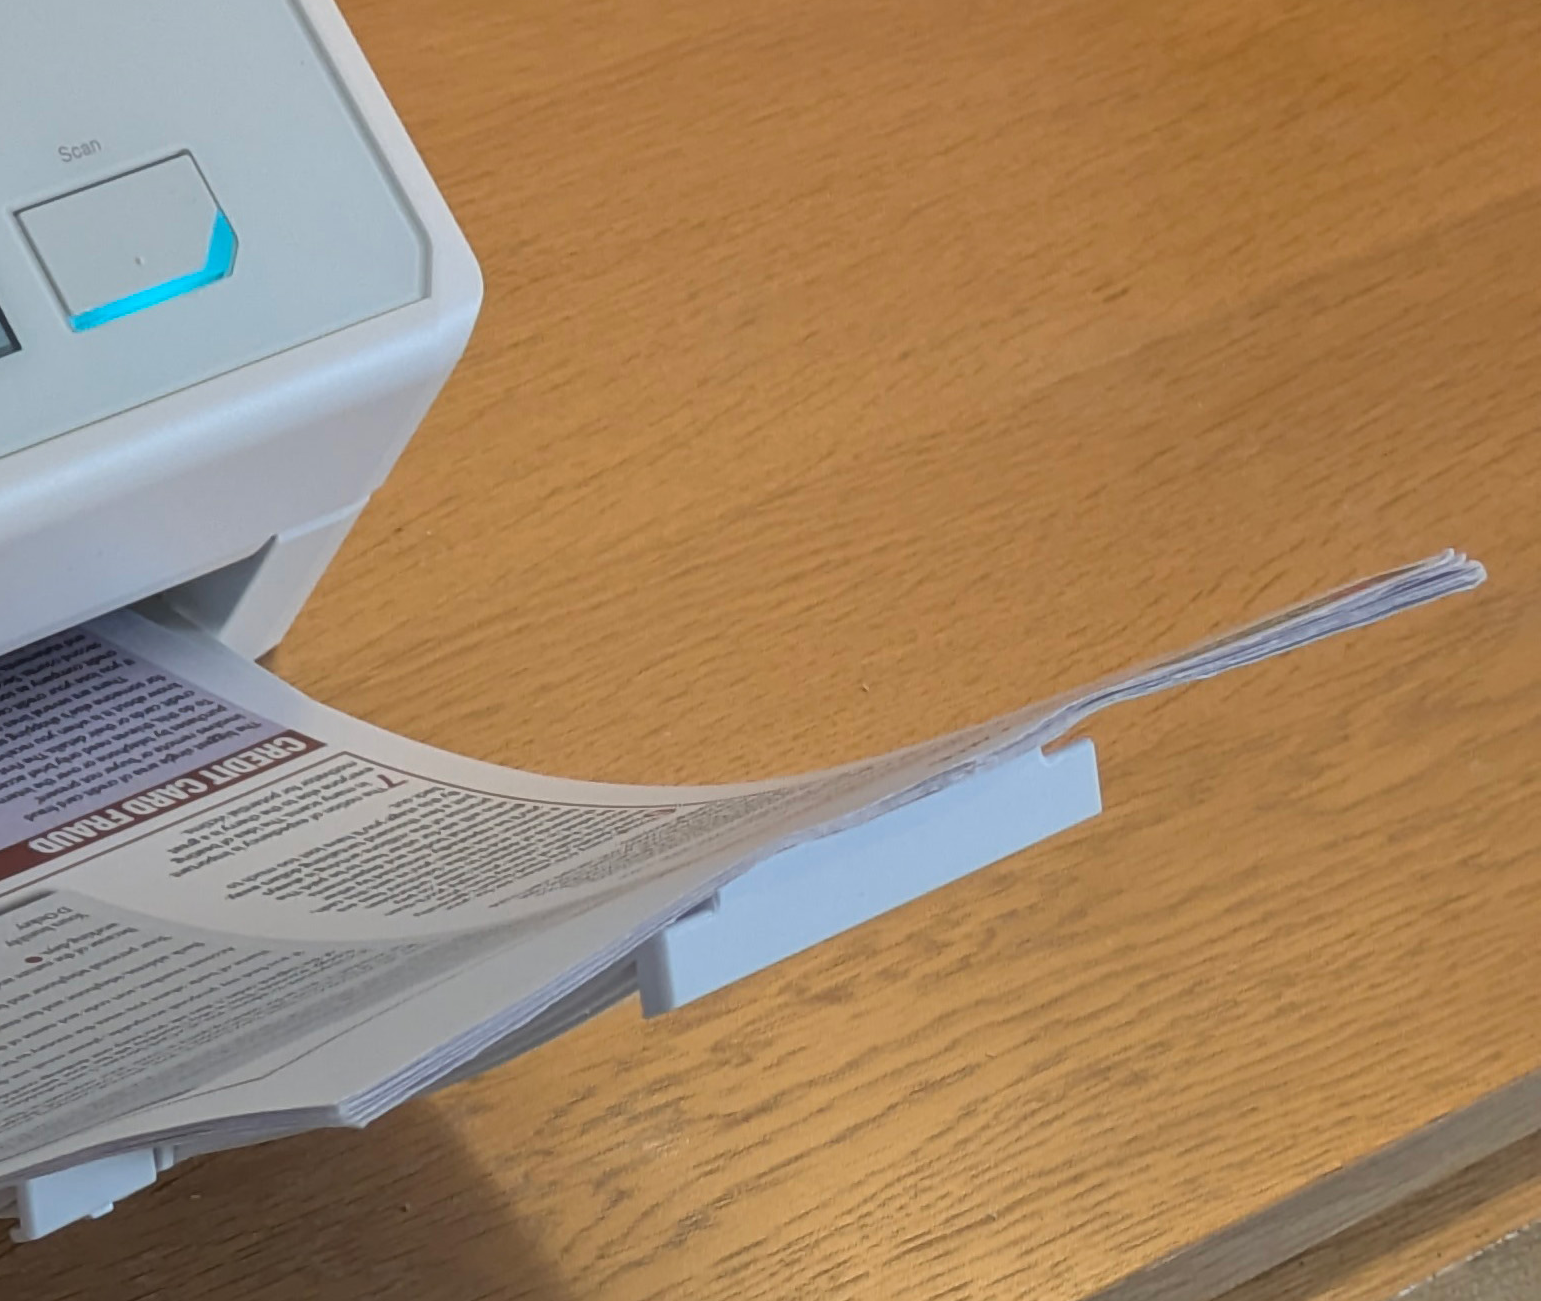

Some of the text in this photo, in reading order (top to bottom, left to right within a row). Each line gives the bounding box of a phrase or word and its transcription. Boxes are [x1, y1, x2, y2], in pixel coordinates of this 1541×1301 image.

[58, 139, 102, 163] Scan
[27, 736, 308, 854] CREDIT CARD FRAUD
